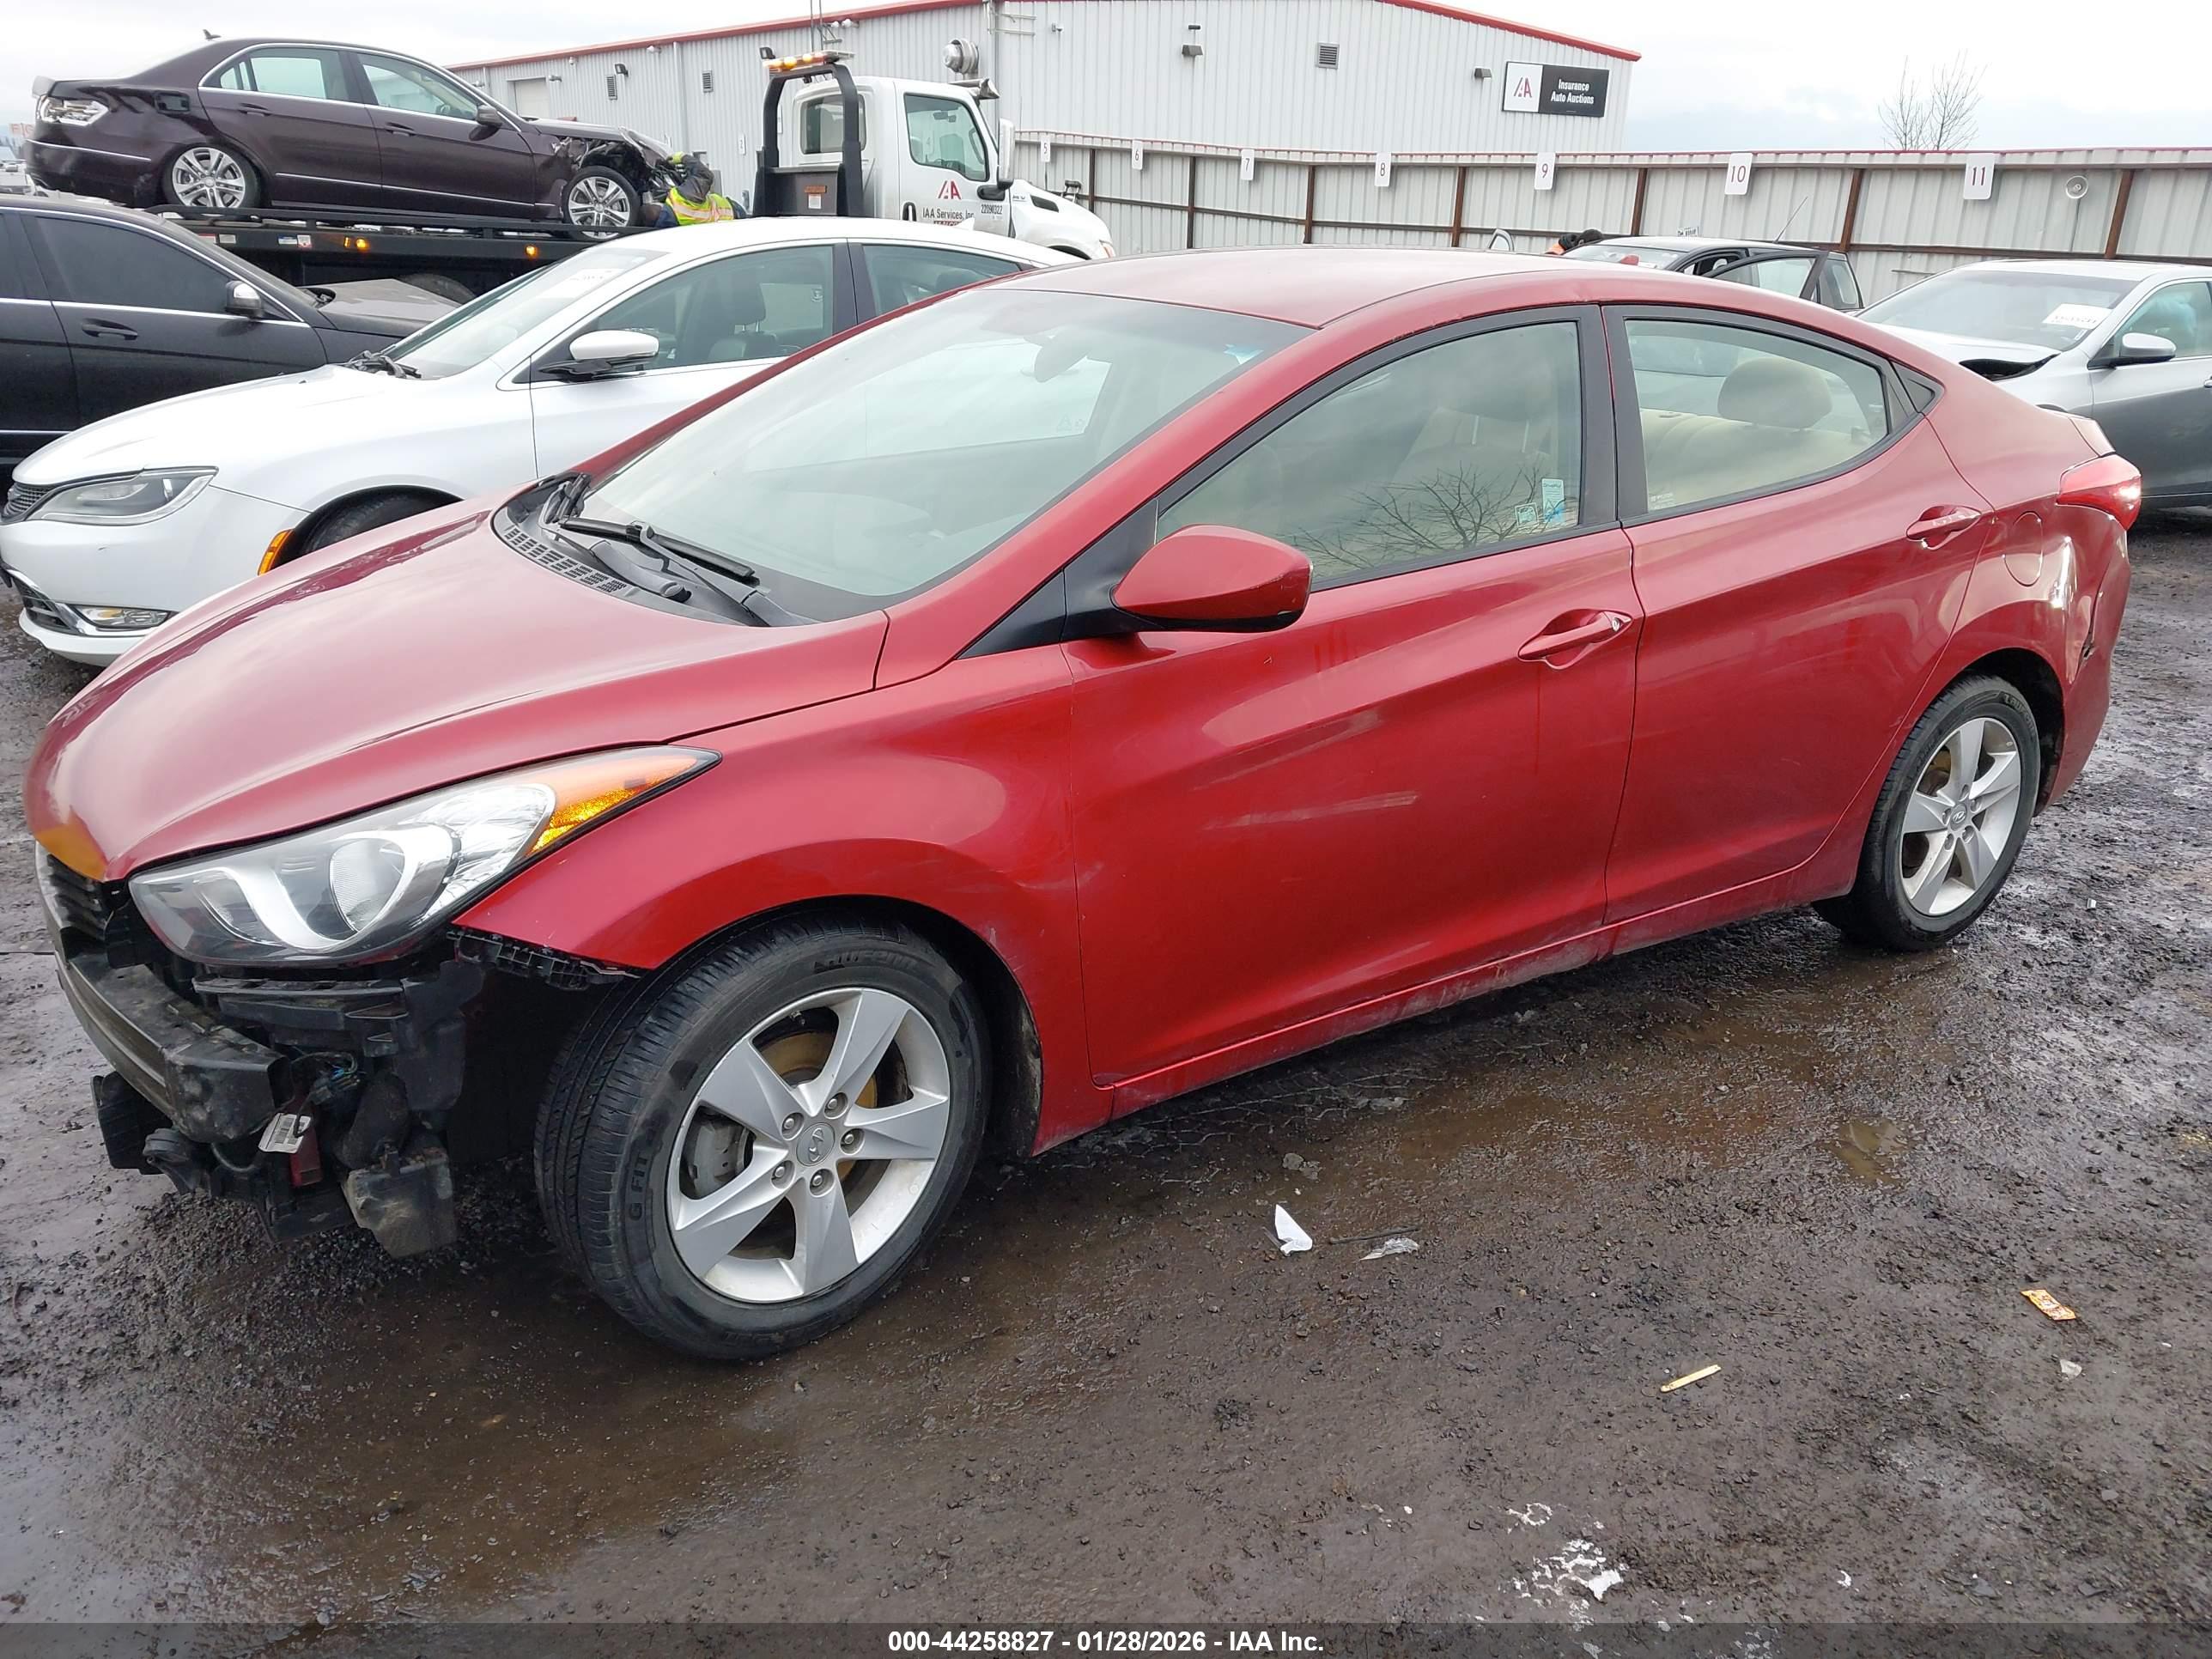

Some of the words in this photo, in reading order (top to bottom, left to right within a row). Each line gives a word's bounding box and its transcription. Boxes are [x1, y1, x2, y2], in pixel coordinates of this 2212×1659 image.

[1559, 79, 1589, 91] Insurance
[1551, 91, 1566, 102] Auto
[1567, 92, 1595, 104] Auctions
[1043, 143, 1048, 155] 5
[1134, 149, 1139, 161] 6
[1245, 158, 1250, 171] 7
[1380, 162, 1386, 177] 8
[1541, 163, 1549, 179] 9
[1730, 165, 1746, 183] 10
[1972, 166, 1986, 186] 11
[922, 207, 935, 218] IAA
